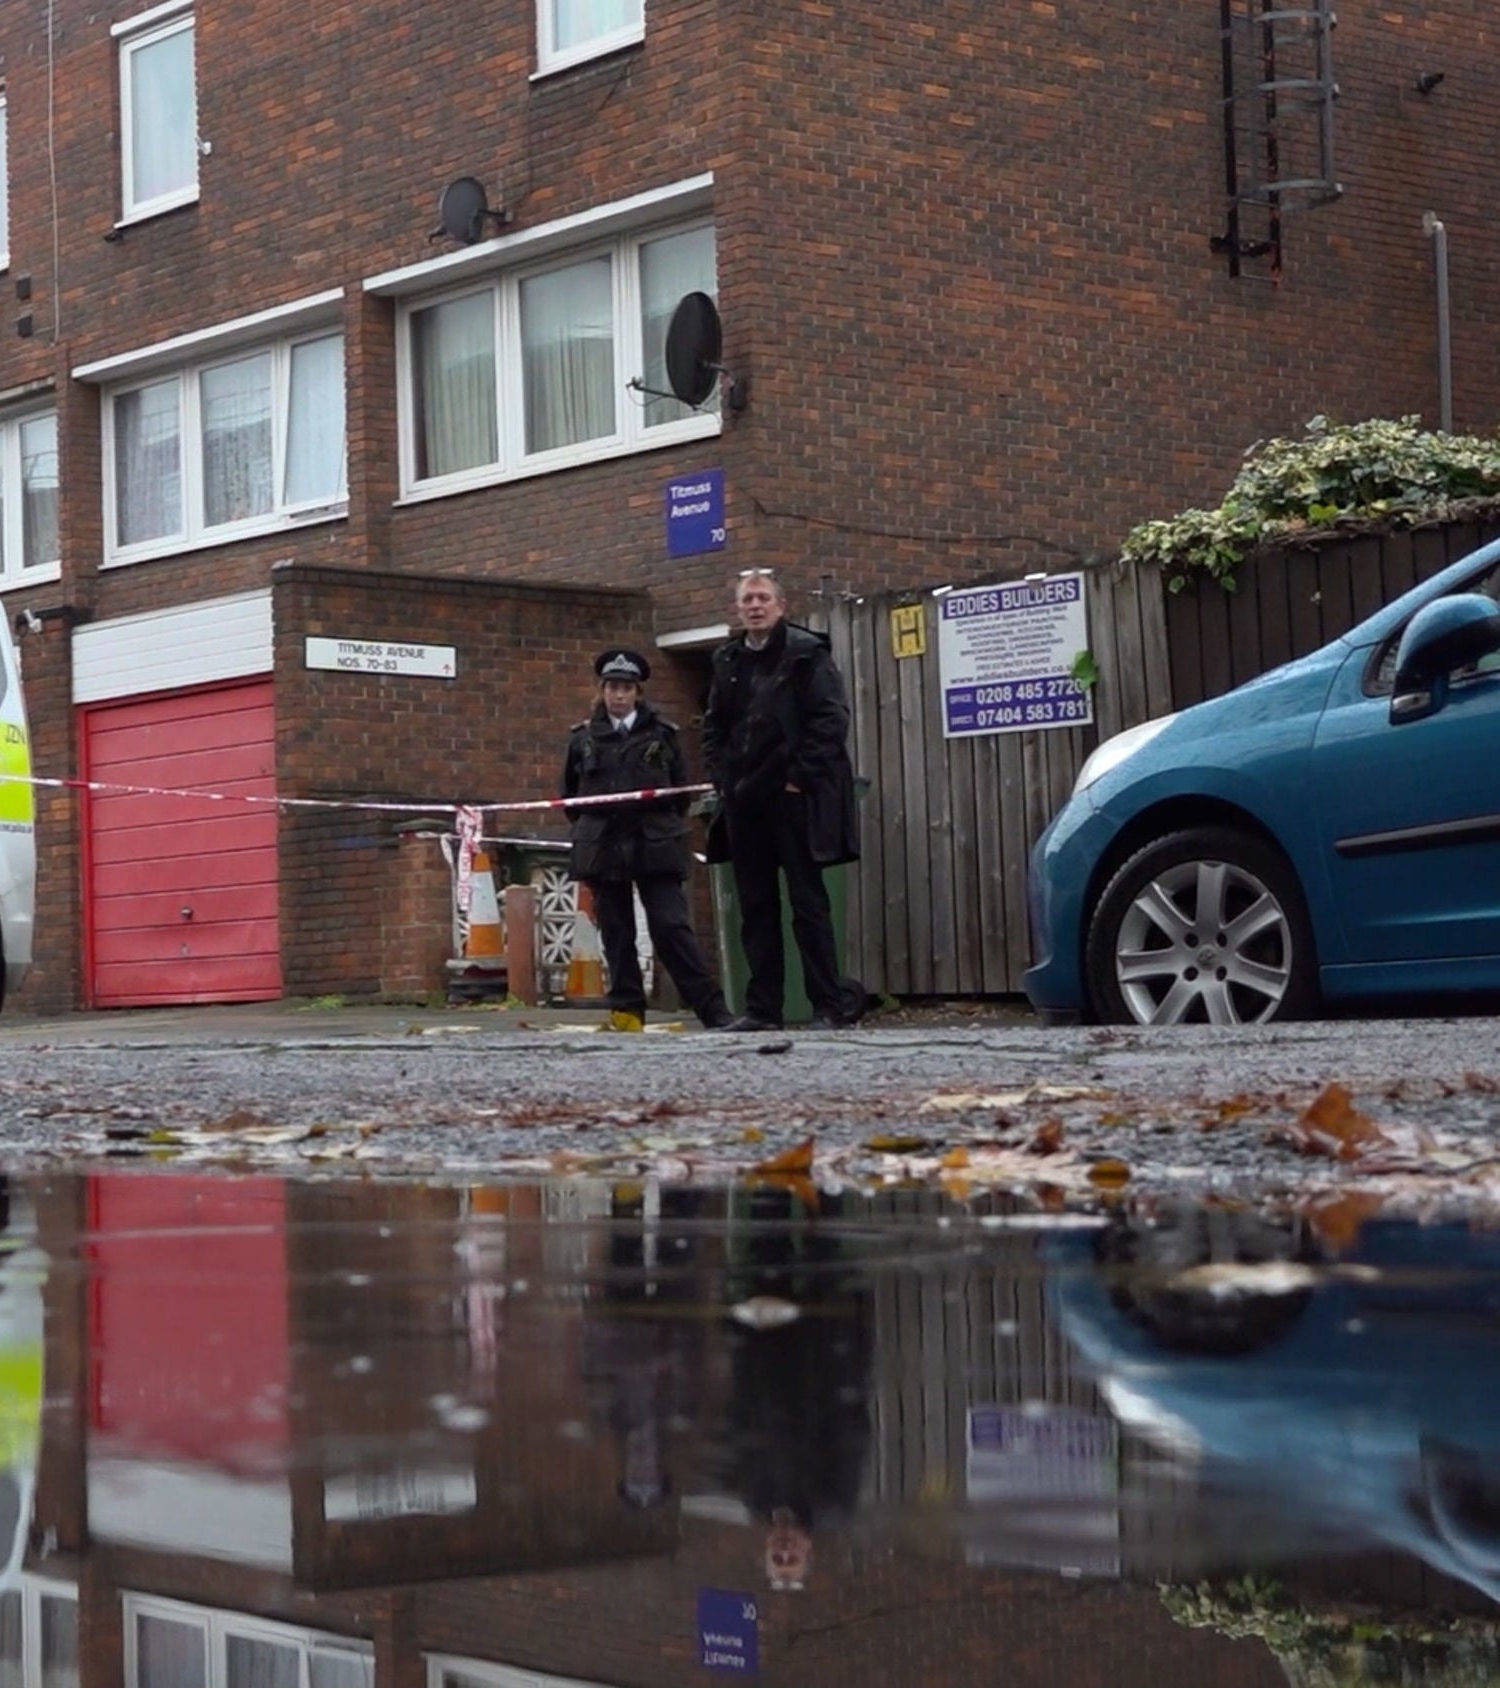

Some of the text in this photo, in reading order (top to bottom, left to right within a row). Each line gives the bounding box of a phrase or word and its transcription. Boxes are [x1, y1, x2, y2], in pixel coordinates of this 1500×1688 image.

[669, 482, 712, 500] Titmuss
[670, 501, 711, 519] Avenue
[710, 527, 726, 543] 70
[946, 581, 1077, 617] EDDIES BUILDERS
[338, 643, 425, 659] TITMUSS AVENUE
[366, 658, 398, 670] 70-83
[976, 686, 1013, 705] 0208
[1015, 681, 1044, 700] 485
[977, 706, 1023, 726] 07404
[1026, 704, 1054, 721] 583
